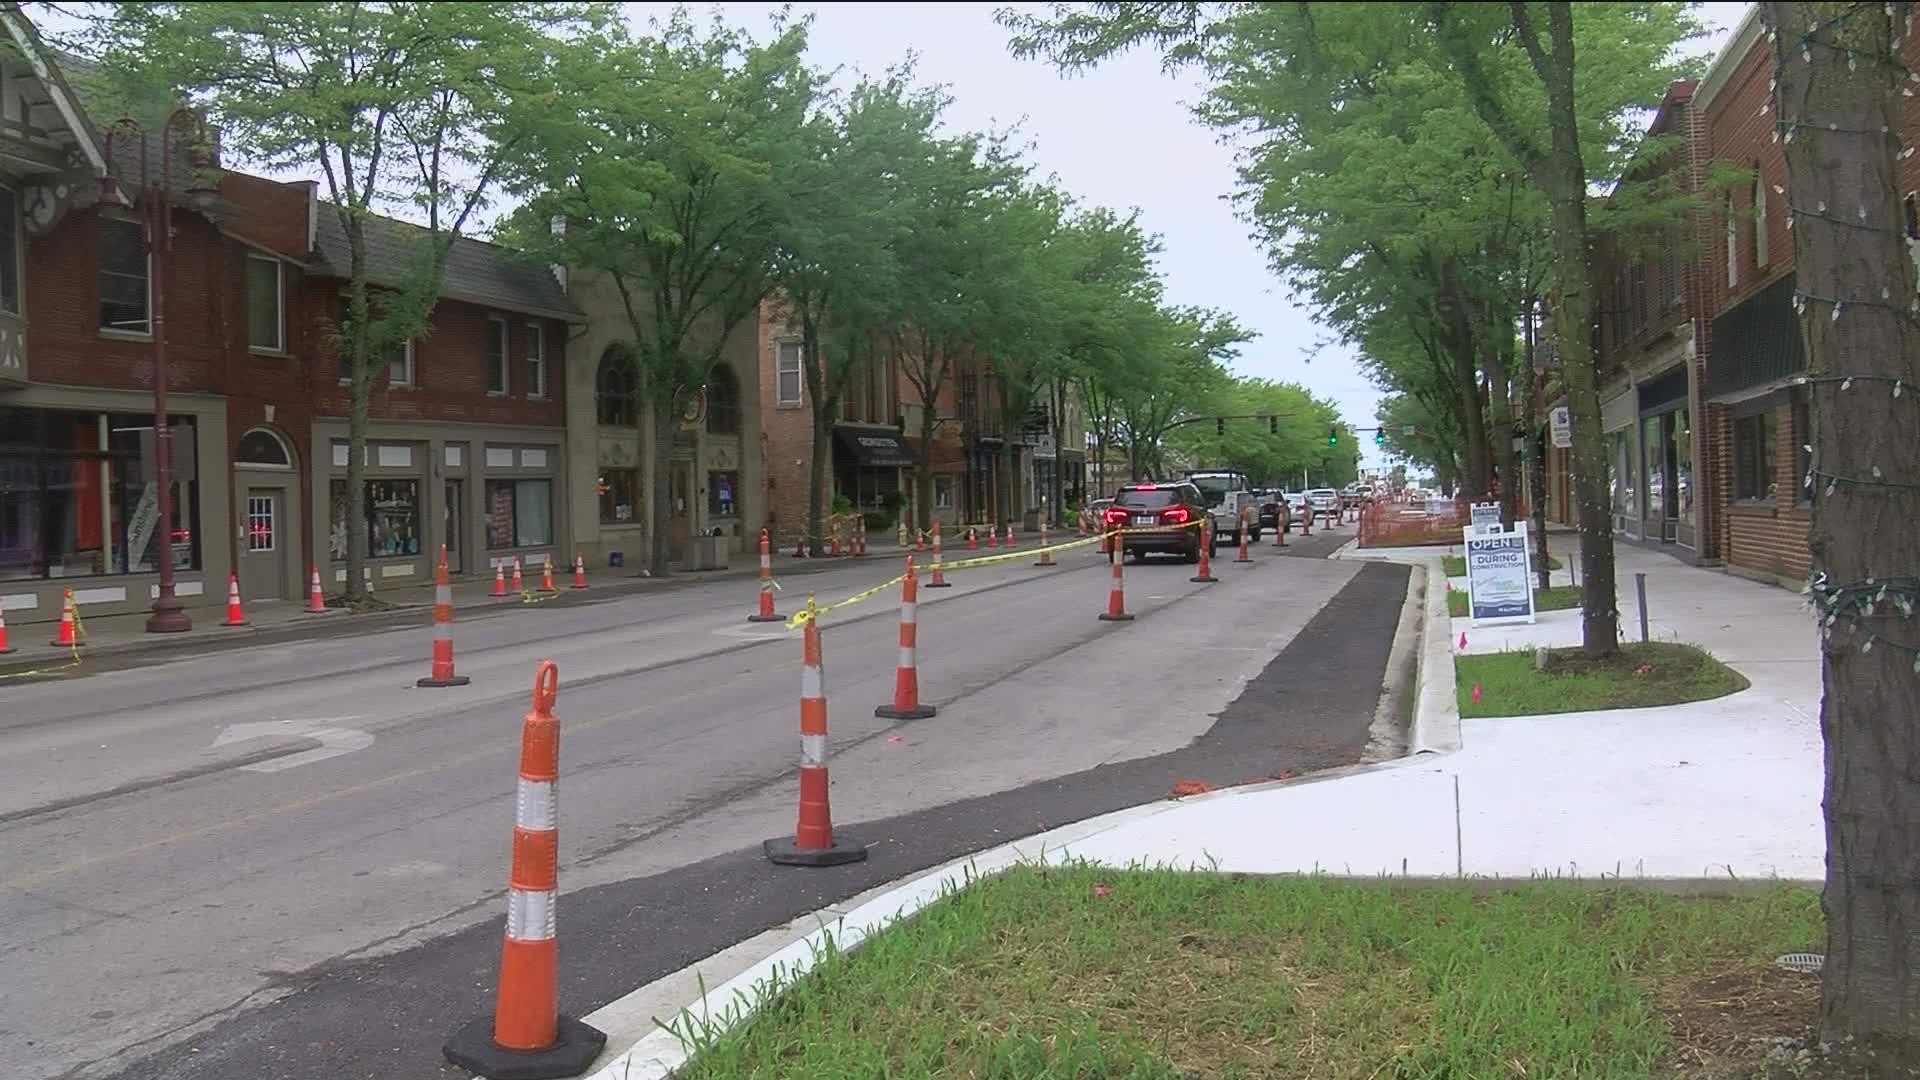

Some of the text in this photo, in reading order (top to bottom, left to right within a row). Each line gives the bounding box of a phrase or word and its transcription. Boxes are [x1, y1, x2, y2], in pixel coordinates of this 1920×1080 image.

[1472, 538, 1510, 549] OPEN
[1477, 554, 1518, 564] DURING
[1471, 562, 1524, 570] CONSTRUCTION
